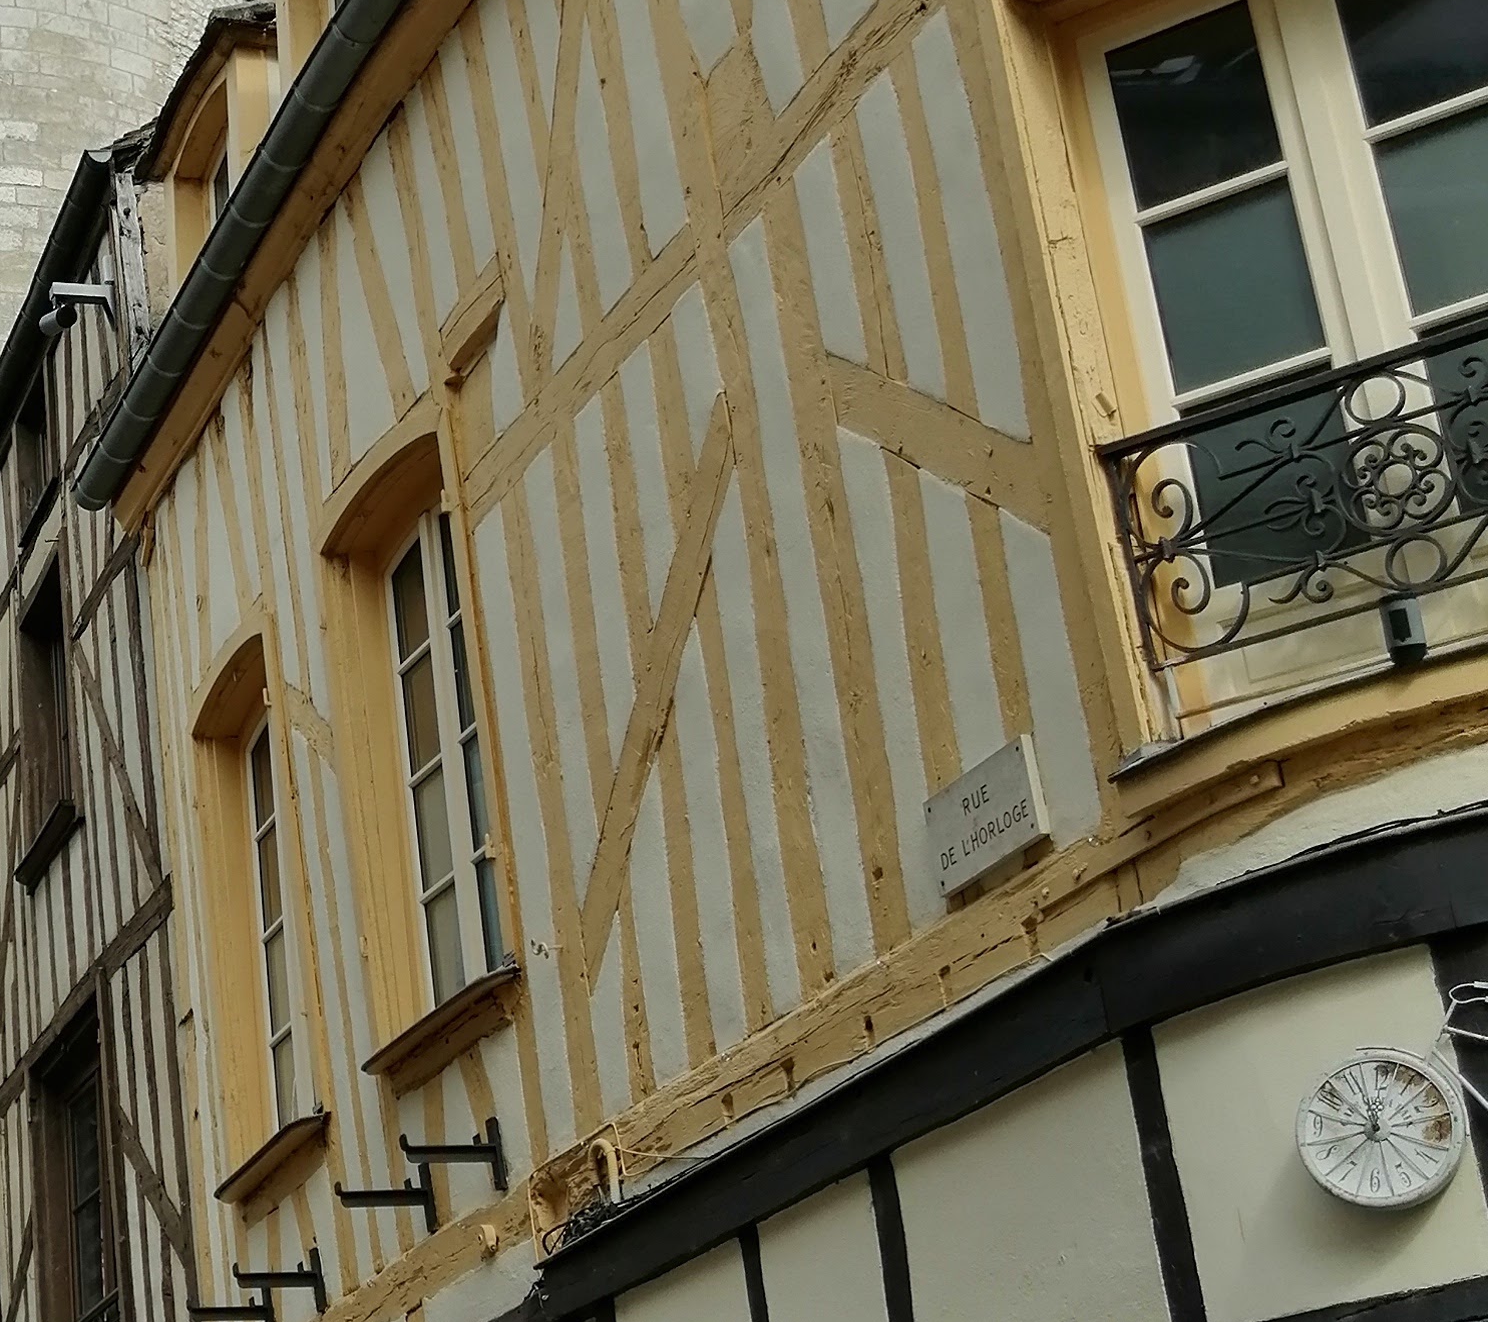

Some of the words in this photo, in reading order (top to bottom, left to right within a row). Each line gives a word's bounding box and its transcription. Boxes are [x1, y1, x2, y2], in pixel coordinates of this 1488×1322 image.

[962, 784, 990, 816] RUE
[940, 847, 957, 871] DE
[962, 799, 1029, 857] L'HORLOGE
